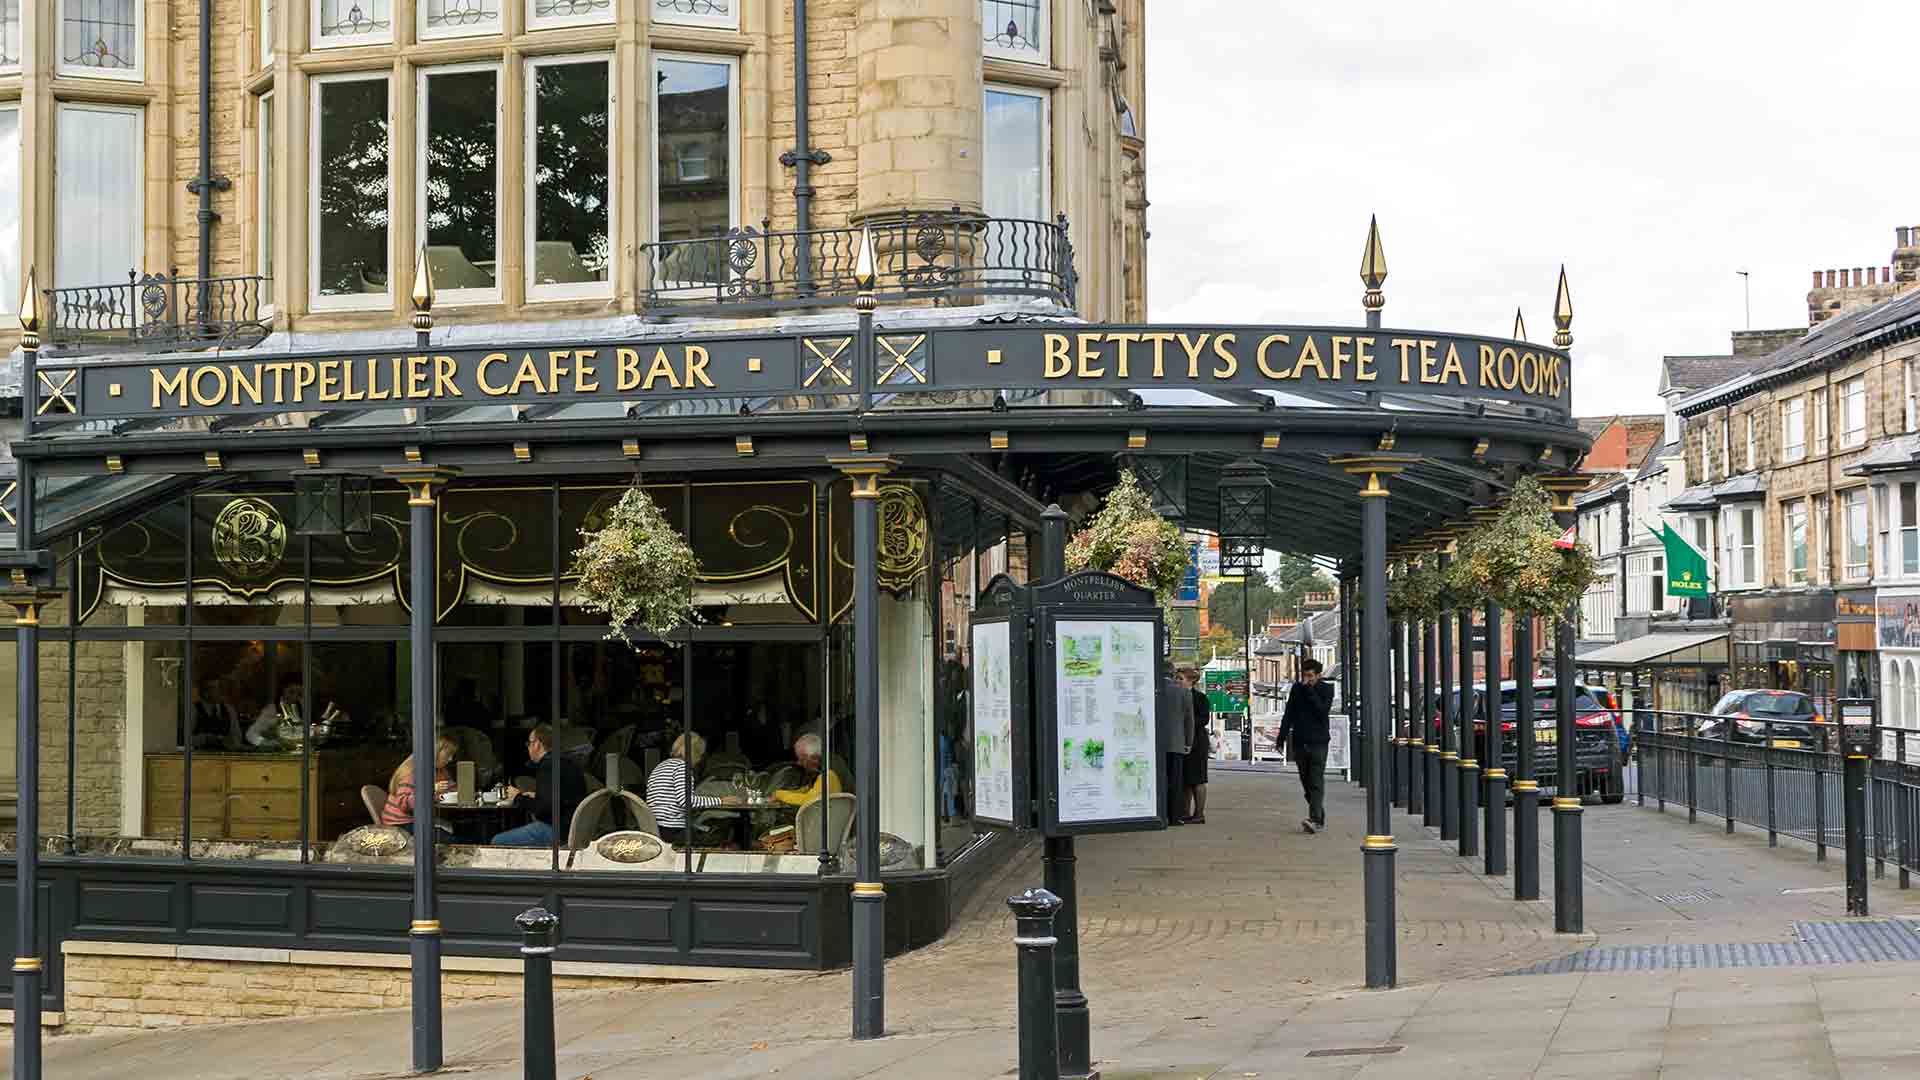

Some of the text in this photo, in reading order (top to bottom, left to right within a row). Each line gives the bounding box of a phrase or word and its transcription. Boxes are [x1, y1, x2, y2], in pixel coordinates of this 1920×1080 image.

[1043, 333, 1561, 399] BETTYS CAFE TEA ROOMS
[150, 346, 715, 408] MONTPELLIER CAFE BAR
[1063, 575, 1126, 593] MONTPELLIER
[1671, 580, 1703, 590] ROLEX
[1073, 591, 1116, 601] QUARTER
